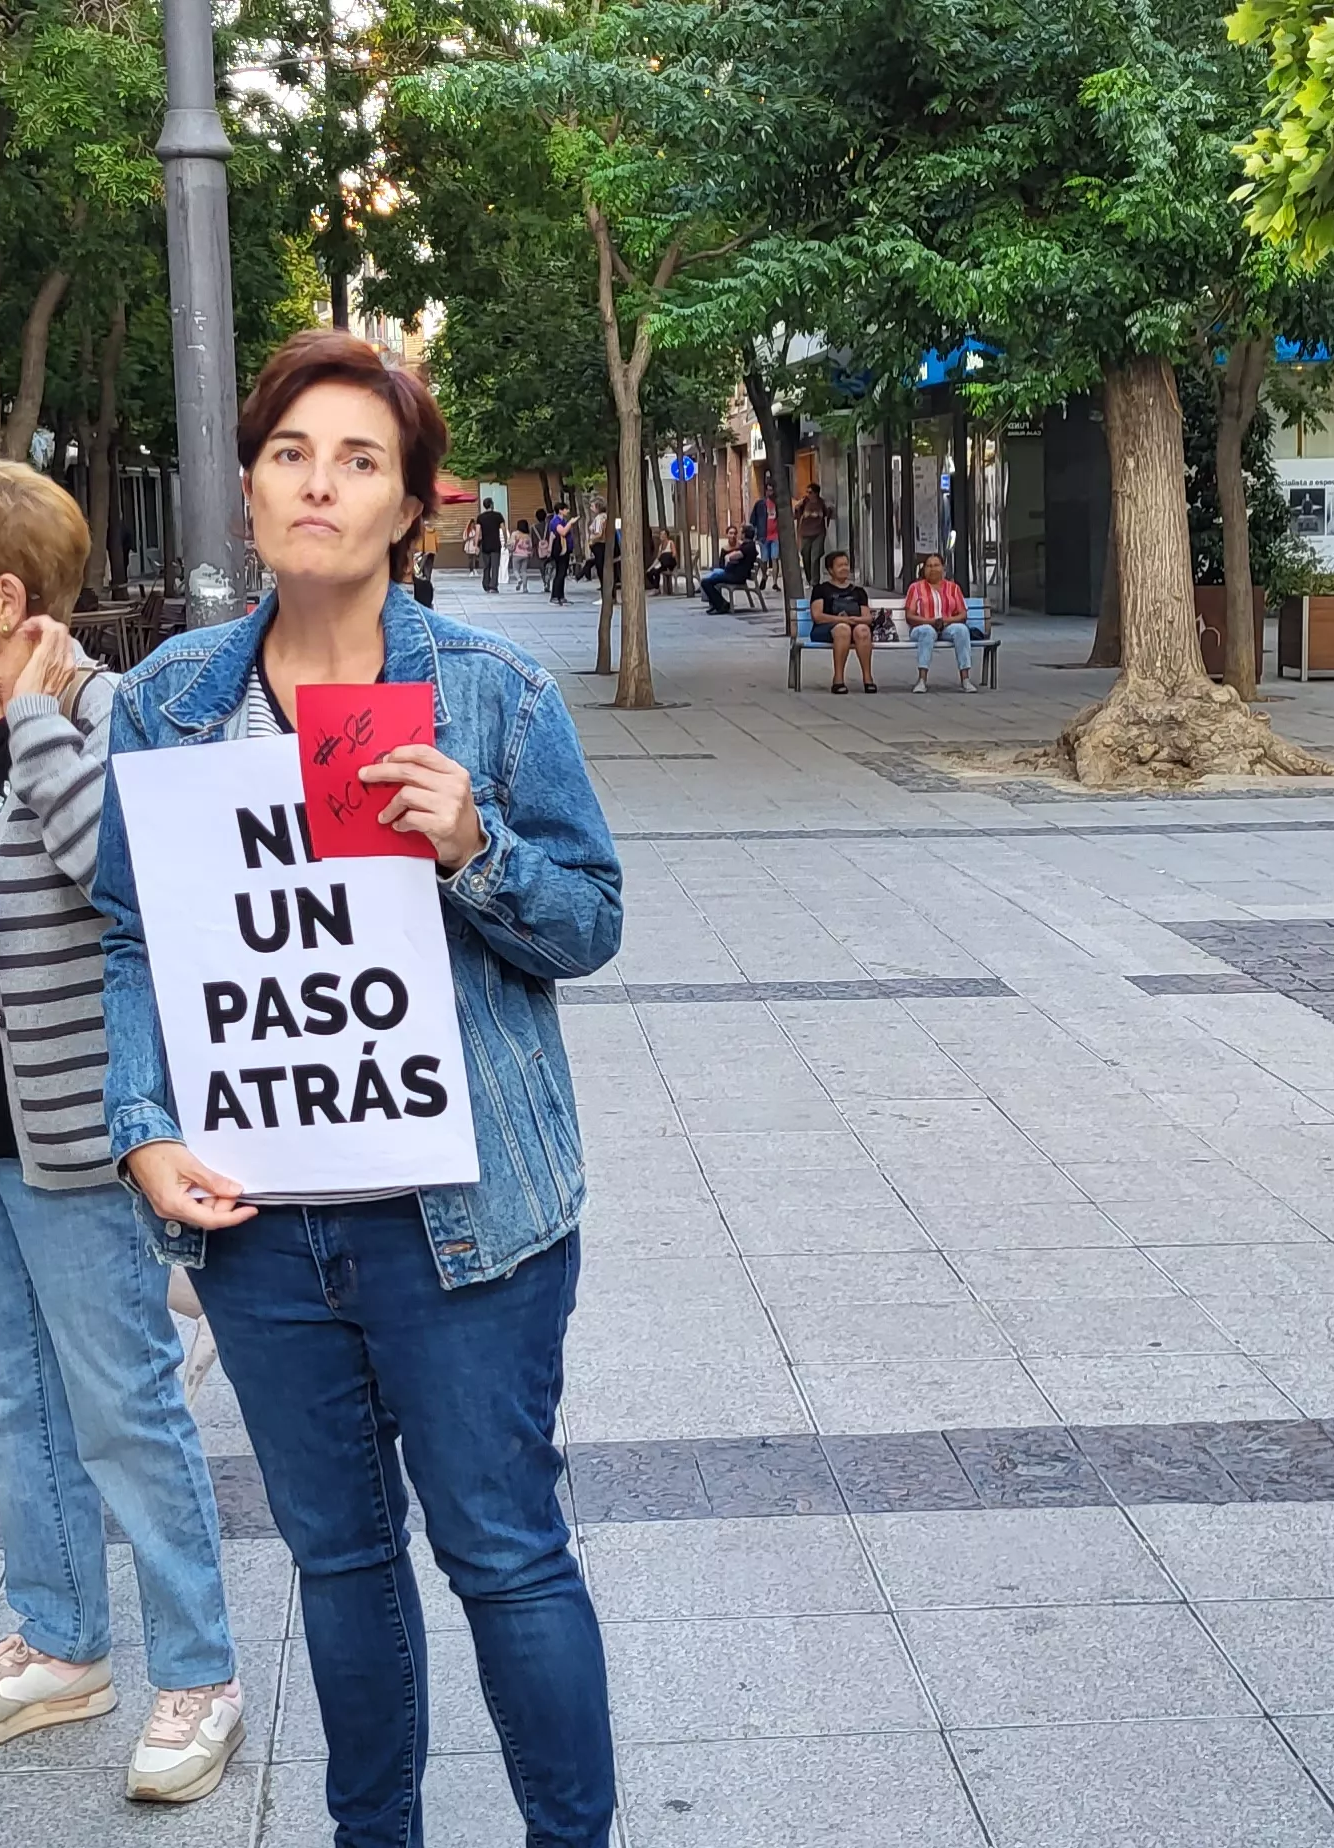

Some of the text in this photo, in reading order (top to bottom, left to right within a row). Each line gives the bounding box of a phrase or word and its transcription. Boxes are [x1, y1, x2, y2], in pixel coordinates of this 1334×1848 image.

[234, 882, 354, 954] UN
[202, 966, 409, 1045] PASO
[203, 1040, 449, 1132] ATRÁS
